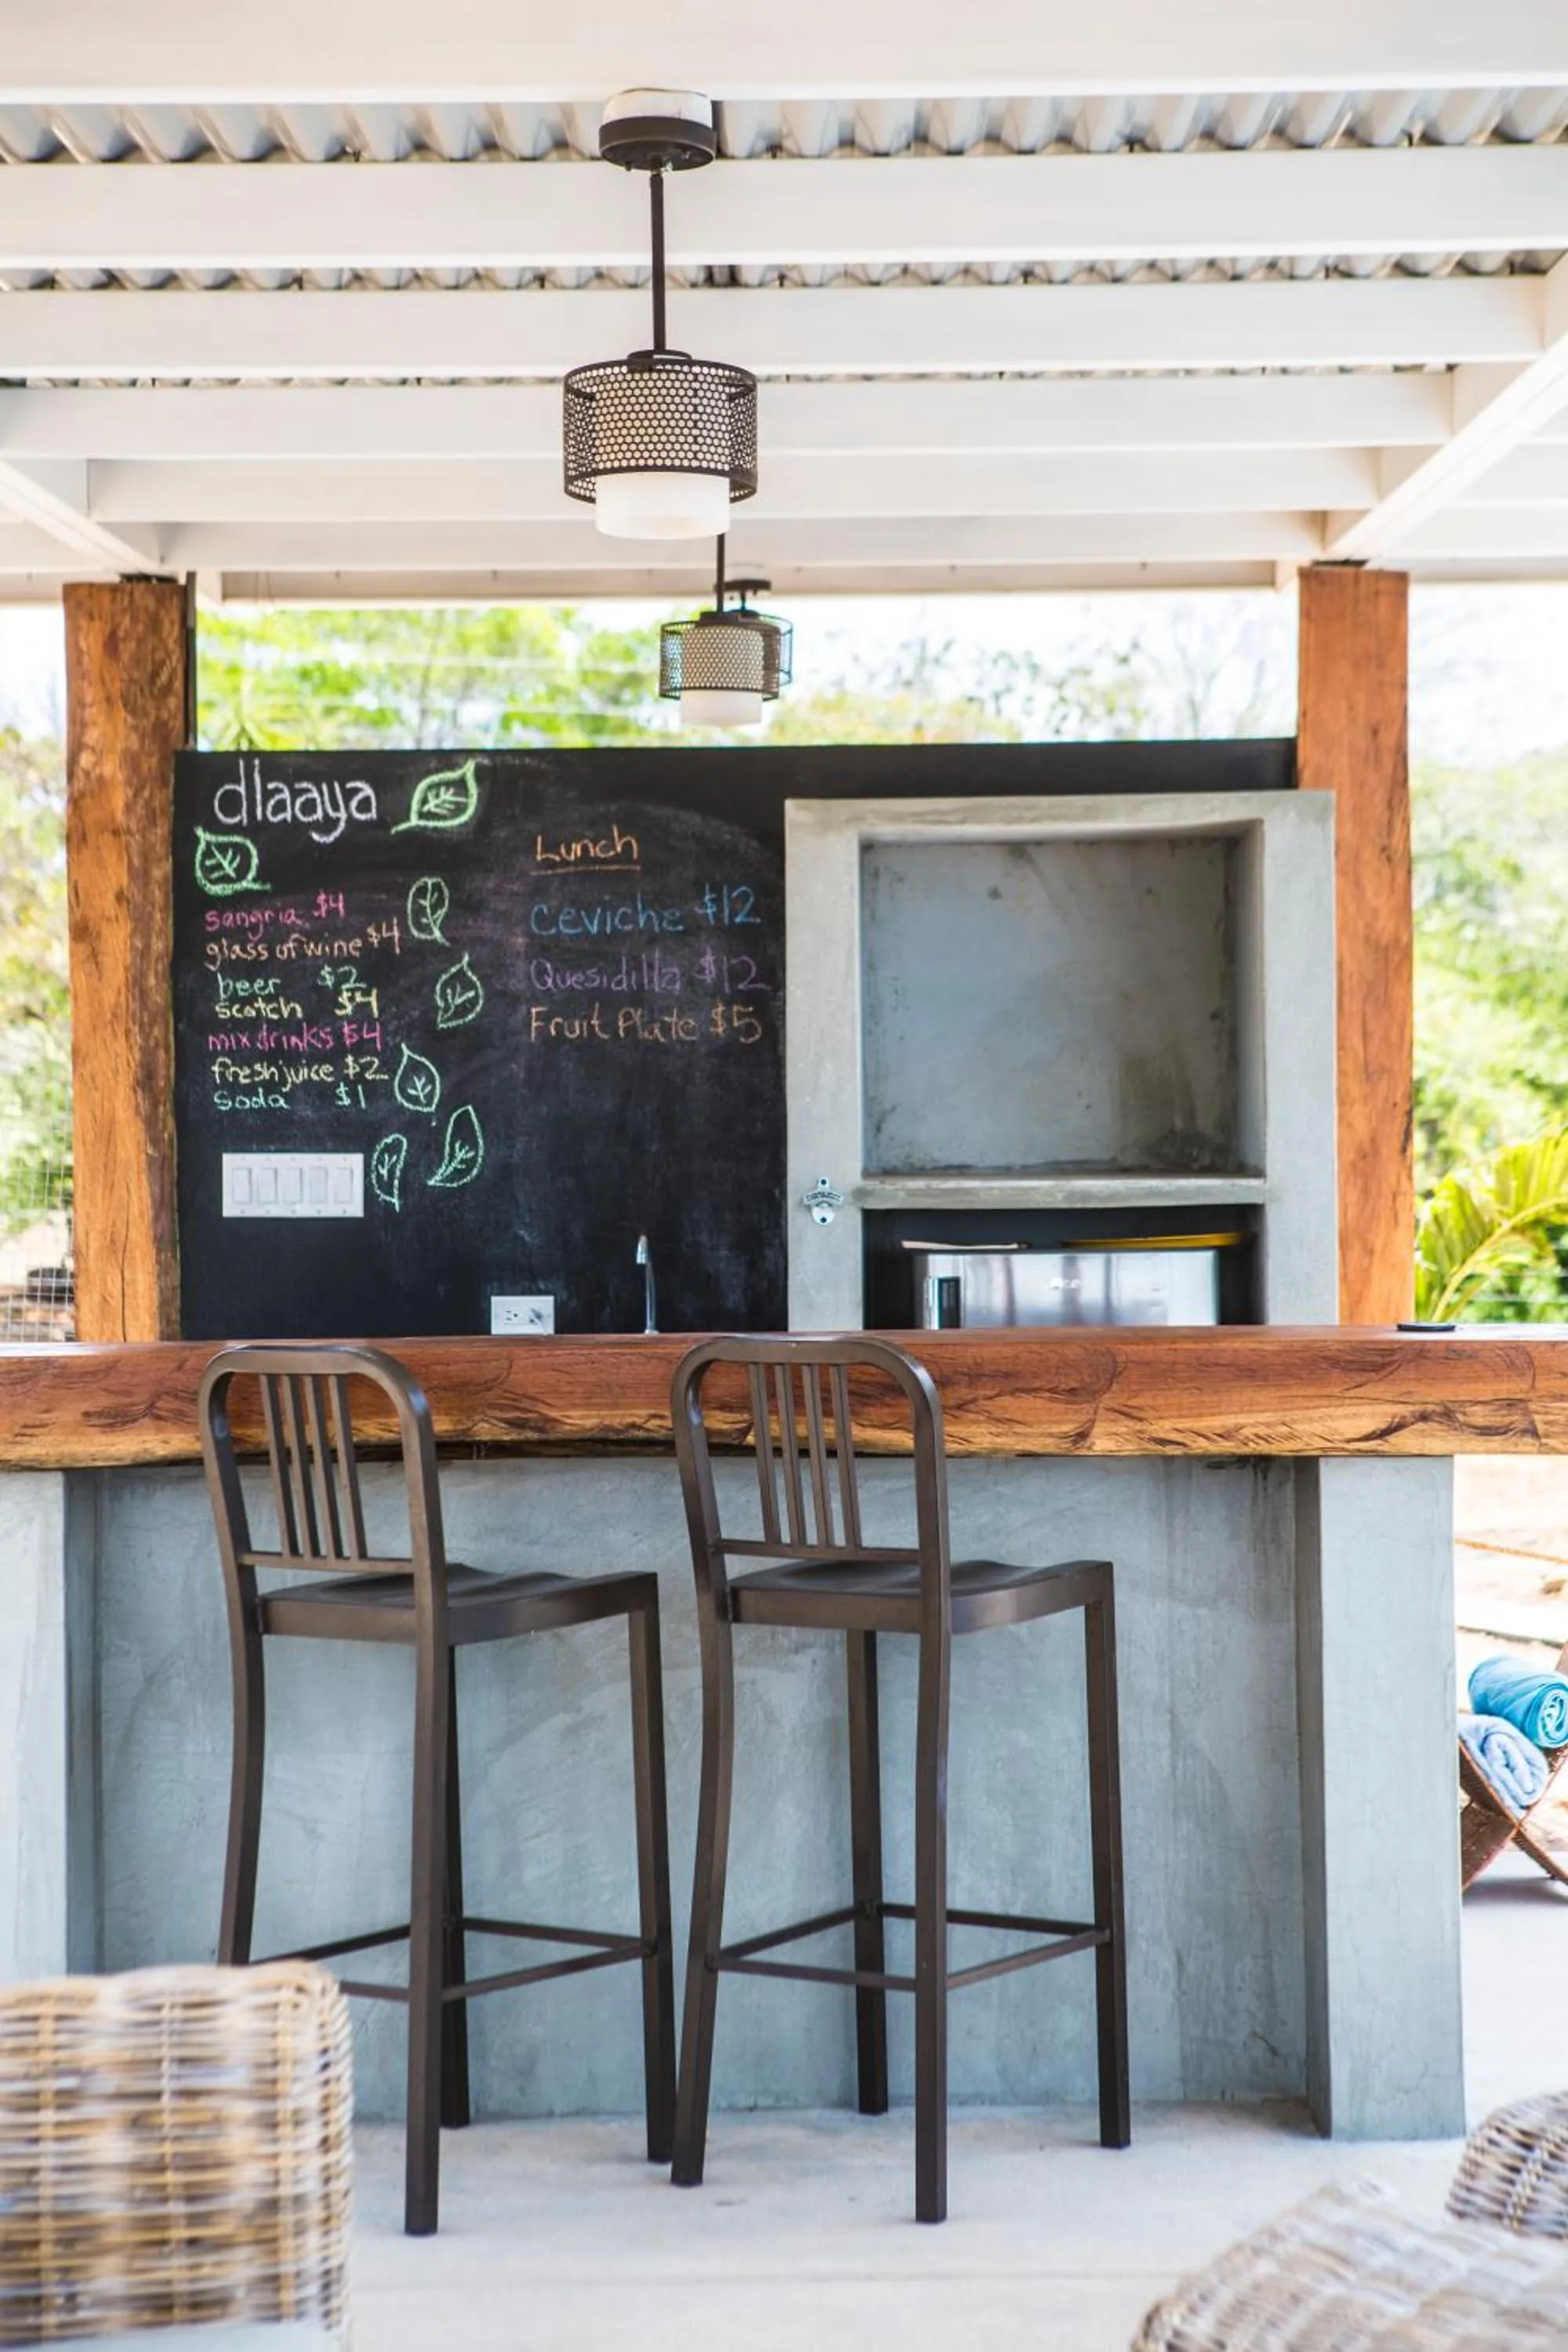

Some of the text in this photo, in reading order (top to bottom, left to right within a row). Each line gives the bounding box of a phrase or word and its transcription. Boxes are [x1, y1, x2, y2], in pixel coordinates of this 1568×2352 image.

[535, 824, 640, 862] Lunch
[314, 891, 345, 920] $4
[530, 883, 761, 936] Ceviche $12
[204, 938, 269, 971] glass
[366, 916, 401, 955] $4
[217, 964, 367, 1000] beer $2
[692, 946, 772, 994] $12
[216, 988, 379, 1020] scotch $4
[529, 1000, 762, 1044] Fruit Plate $5
[209, 1022, 381, 1051] mix drinks $4
[343, 1054, 389, 1080] $2
[336, 1082, 366, 1109] $1
